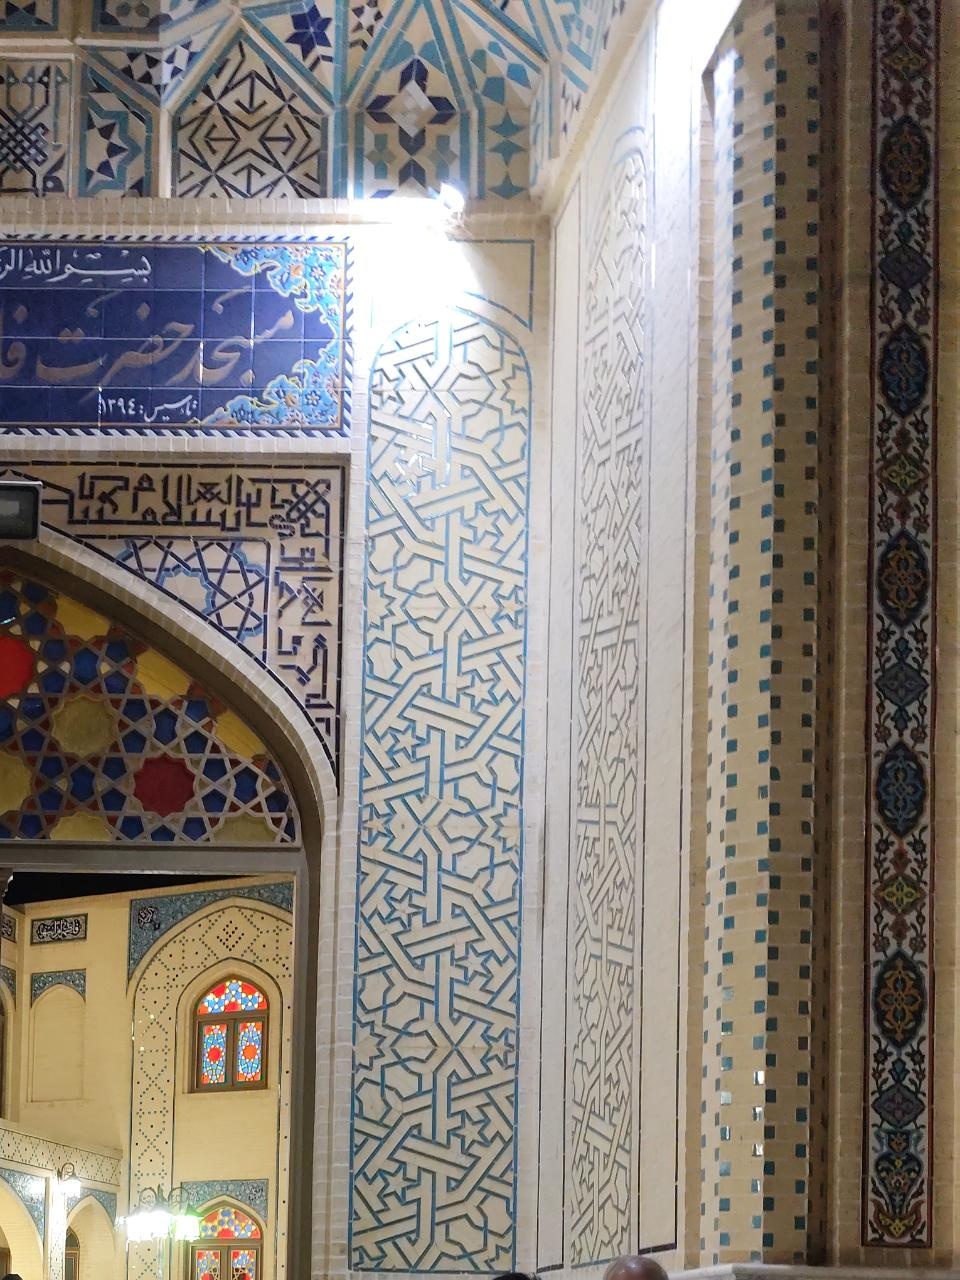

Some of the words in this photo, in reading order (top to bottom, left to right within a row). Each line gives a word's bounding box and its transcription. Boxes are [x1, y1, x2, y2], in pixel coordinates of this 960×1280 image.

[23, 249, 61, 280] الله
[36, 290, 195, 402] حضرت
[165, 286, 295, 387] مسجد
